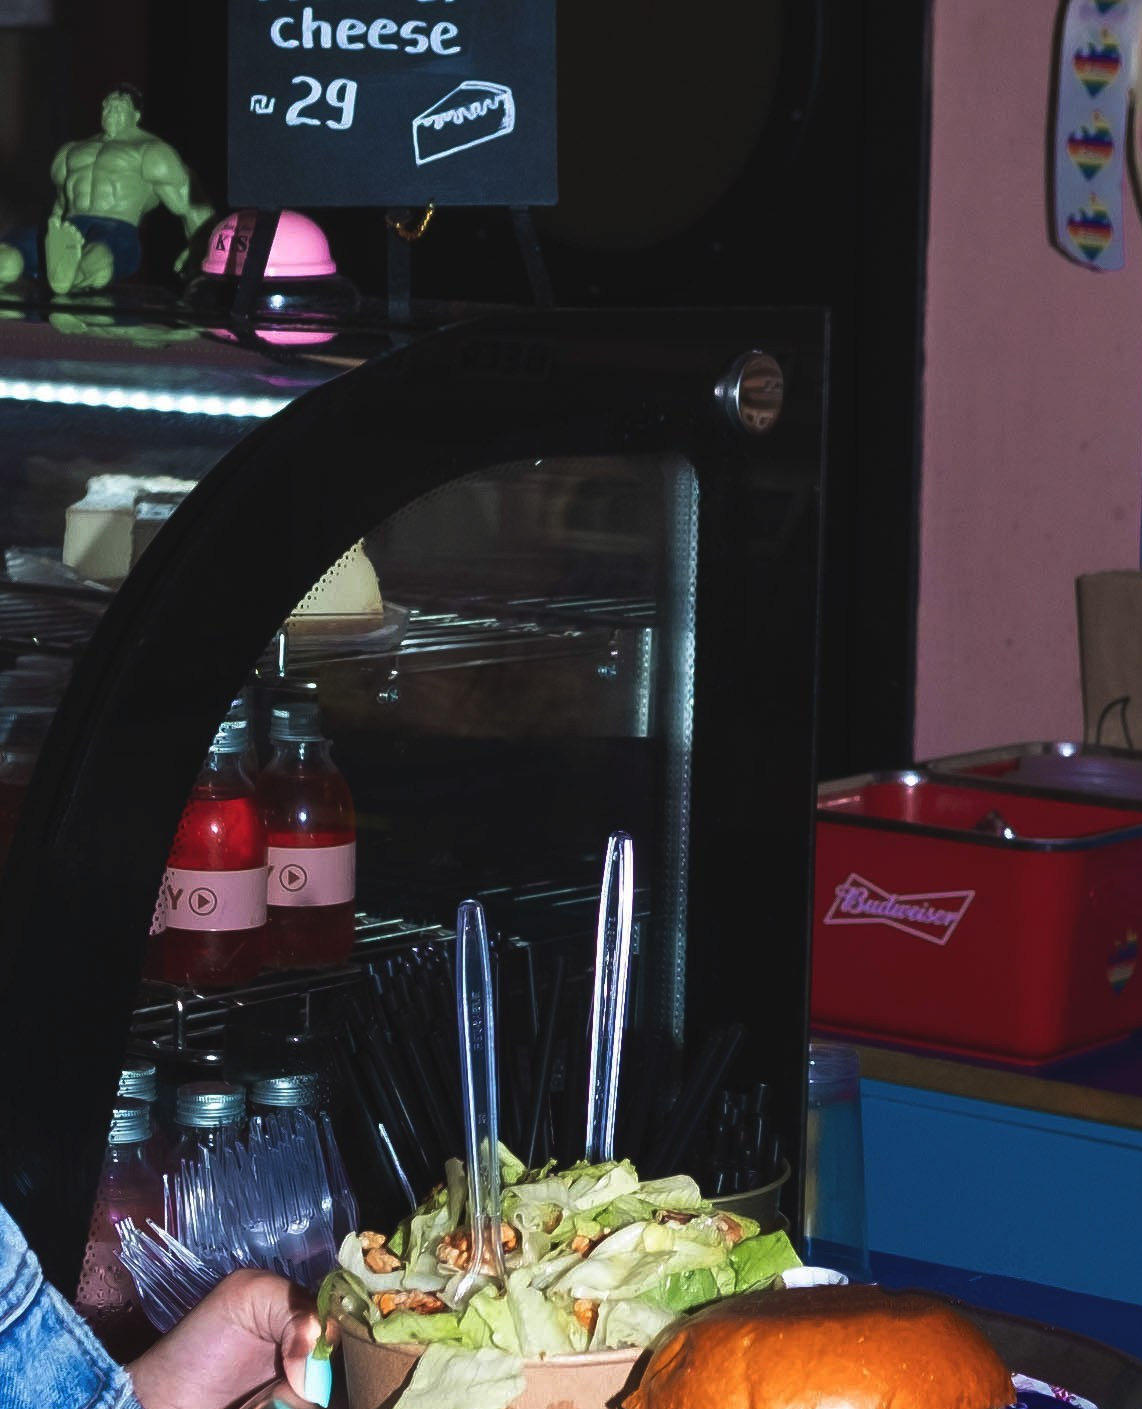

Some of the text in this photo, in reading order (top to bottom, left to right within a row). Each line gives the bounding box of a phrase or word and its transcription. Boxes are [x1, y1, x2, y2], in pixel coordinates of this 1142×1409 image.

[270, 6, 461, 55] cheese
[285, 75, 358, 130] 29
[834, 883, 960, 926] Budweiser
